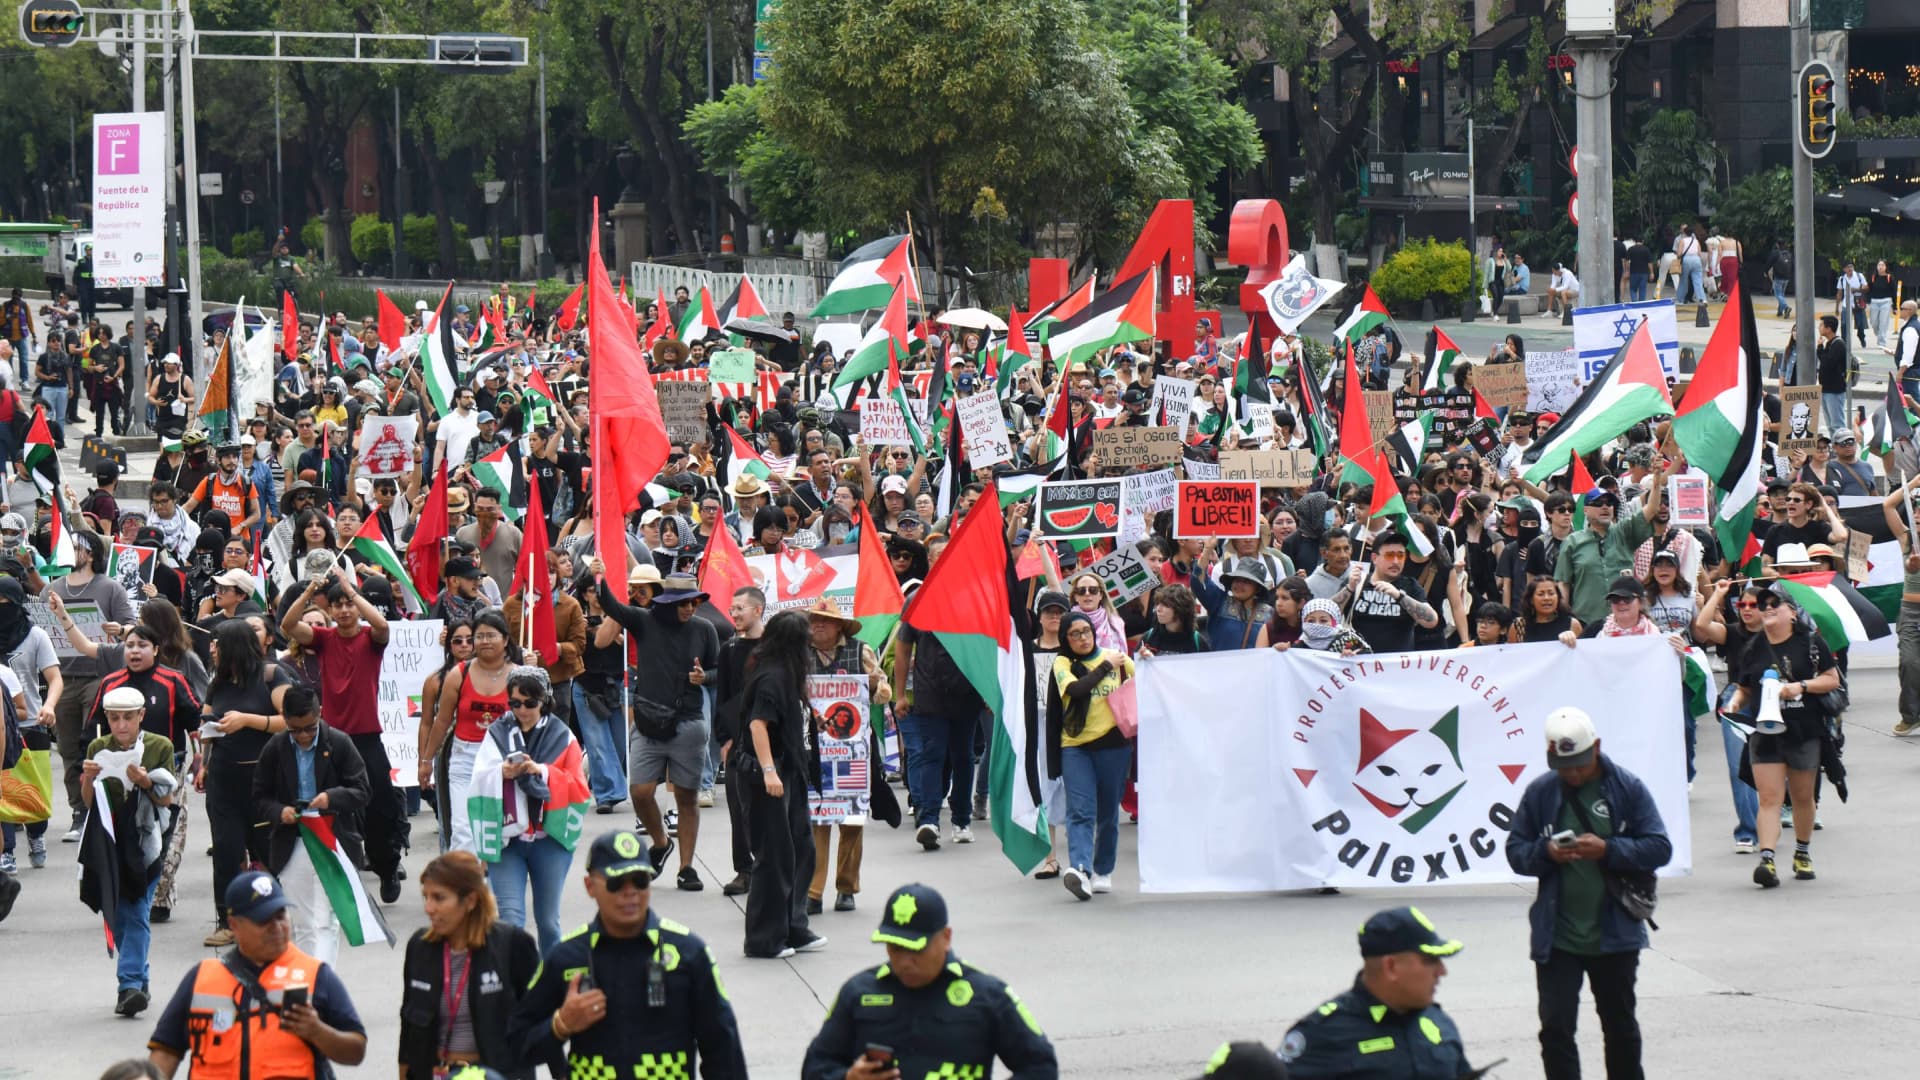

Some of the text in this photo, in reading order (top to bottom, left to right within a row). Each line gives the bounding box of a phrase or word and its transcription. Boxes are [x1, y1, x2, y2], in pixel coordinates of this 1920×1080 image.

[106, 129, 131, 139] ZONA
[111, 140, 127, 171] F
[98, 185, 149, 195] Fuente de la
[98, 200, 140, 212] República
[1160, 383, 1187, 398] VIVA
[1785, 391, 1819, 401] CRIMINAL
[1191, 504, 1252, 527] LIBRE!!
[1355, 600, 1402, 616] IS DEAD
[395, 627, 435, 649] CIELO
[1293, 655, 1525, 743] PROTESTA DIVERGENTE
[1312, 802, 1518, 884] Palexico
